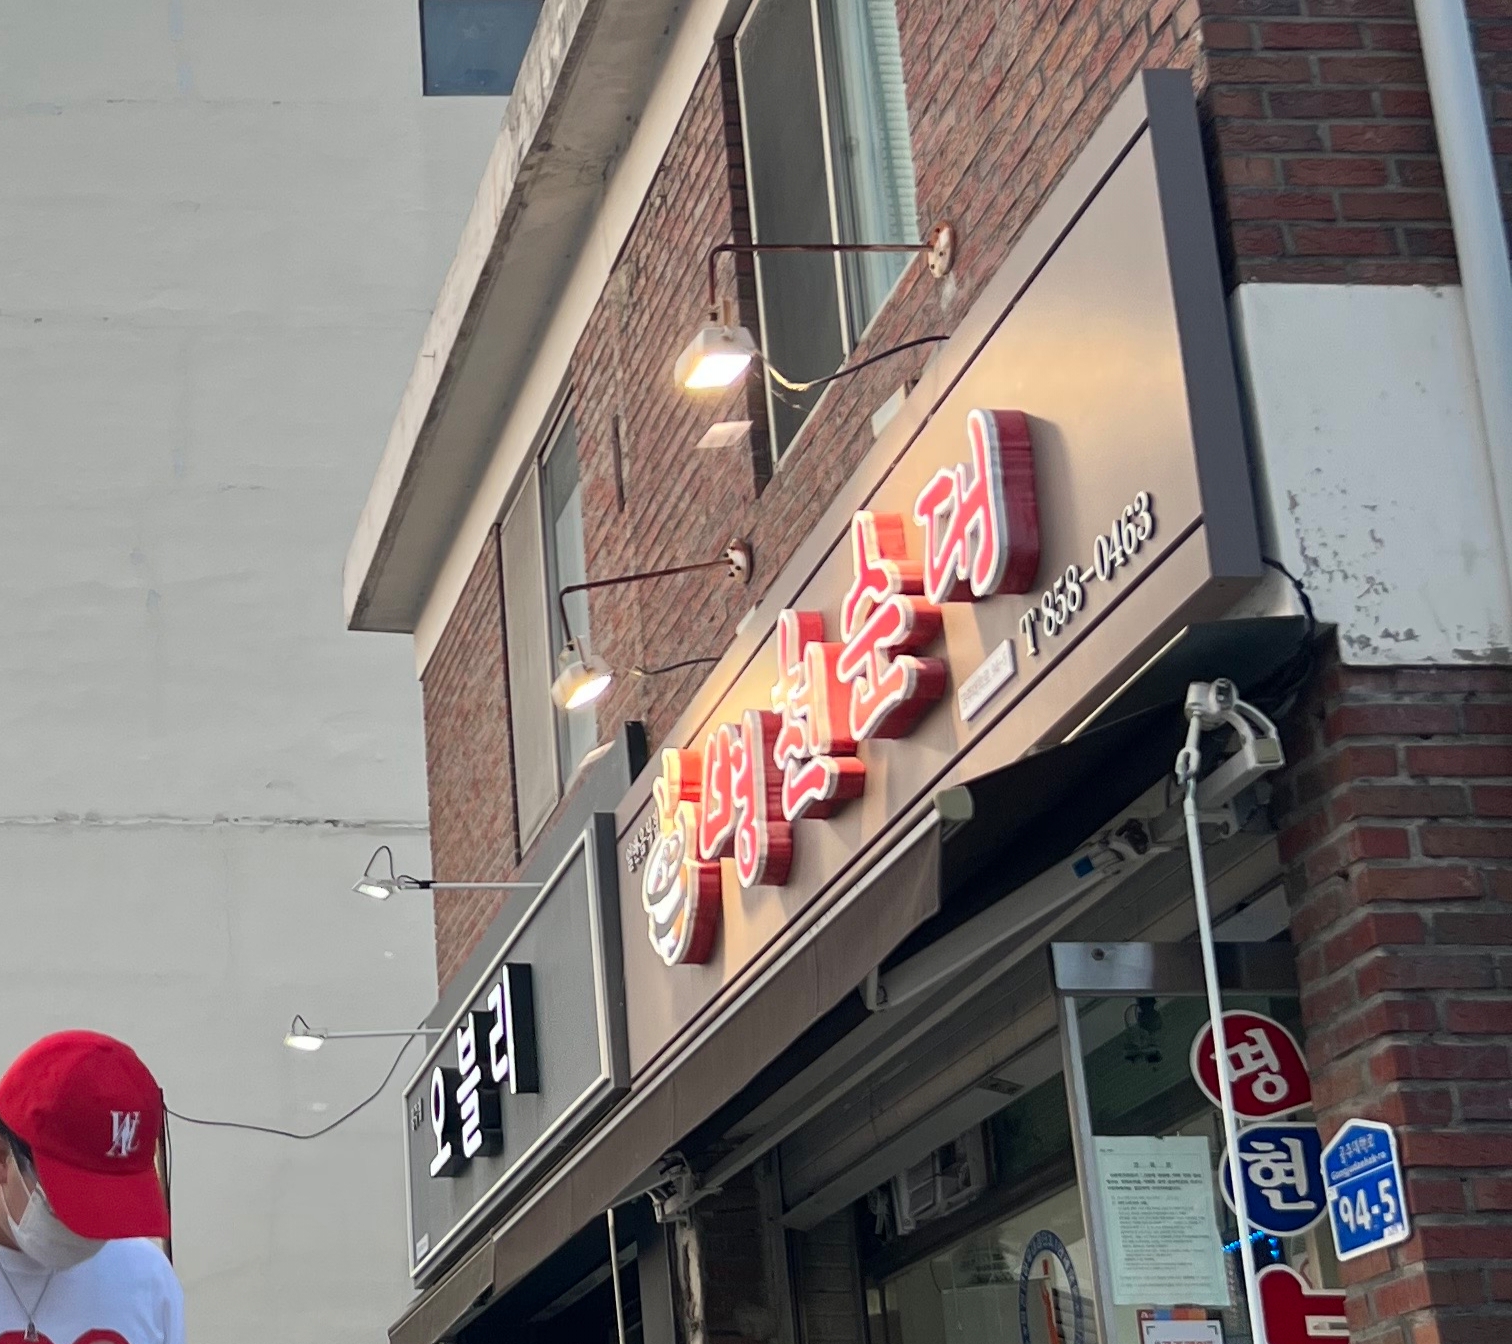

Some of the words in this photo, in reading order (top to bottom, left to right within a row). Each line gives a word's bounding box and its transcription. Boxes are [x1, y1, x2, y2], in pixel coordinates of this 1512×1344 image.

[699, 408, 1013, 888] 병천순대
[1019, 607, 1038, 657] T
[1040, 490, 1153, 637] 858-0463
[429, 962, 518, 1178] 오블리
[1237, 1136, 1318, 1211] 현
[1338, 1178, 1396, 1234] 94-5
